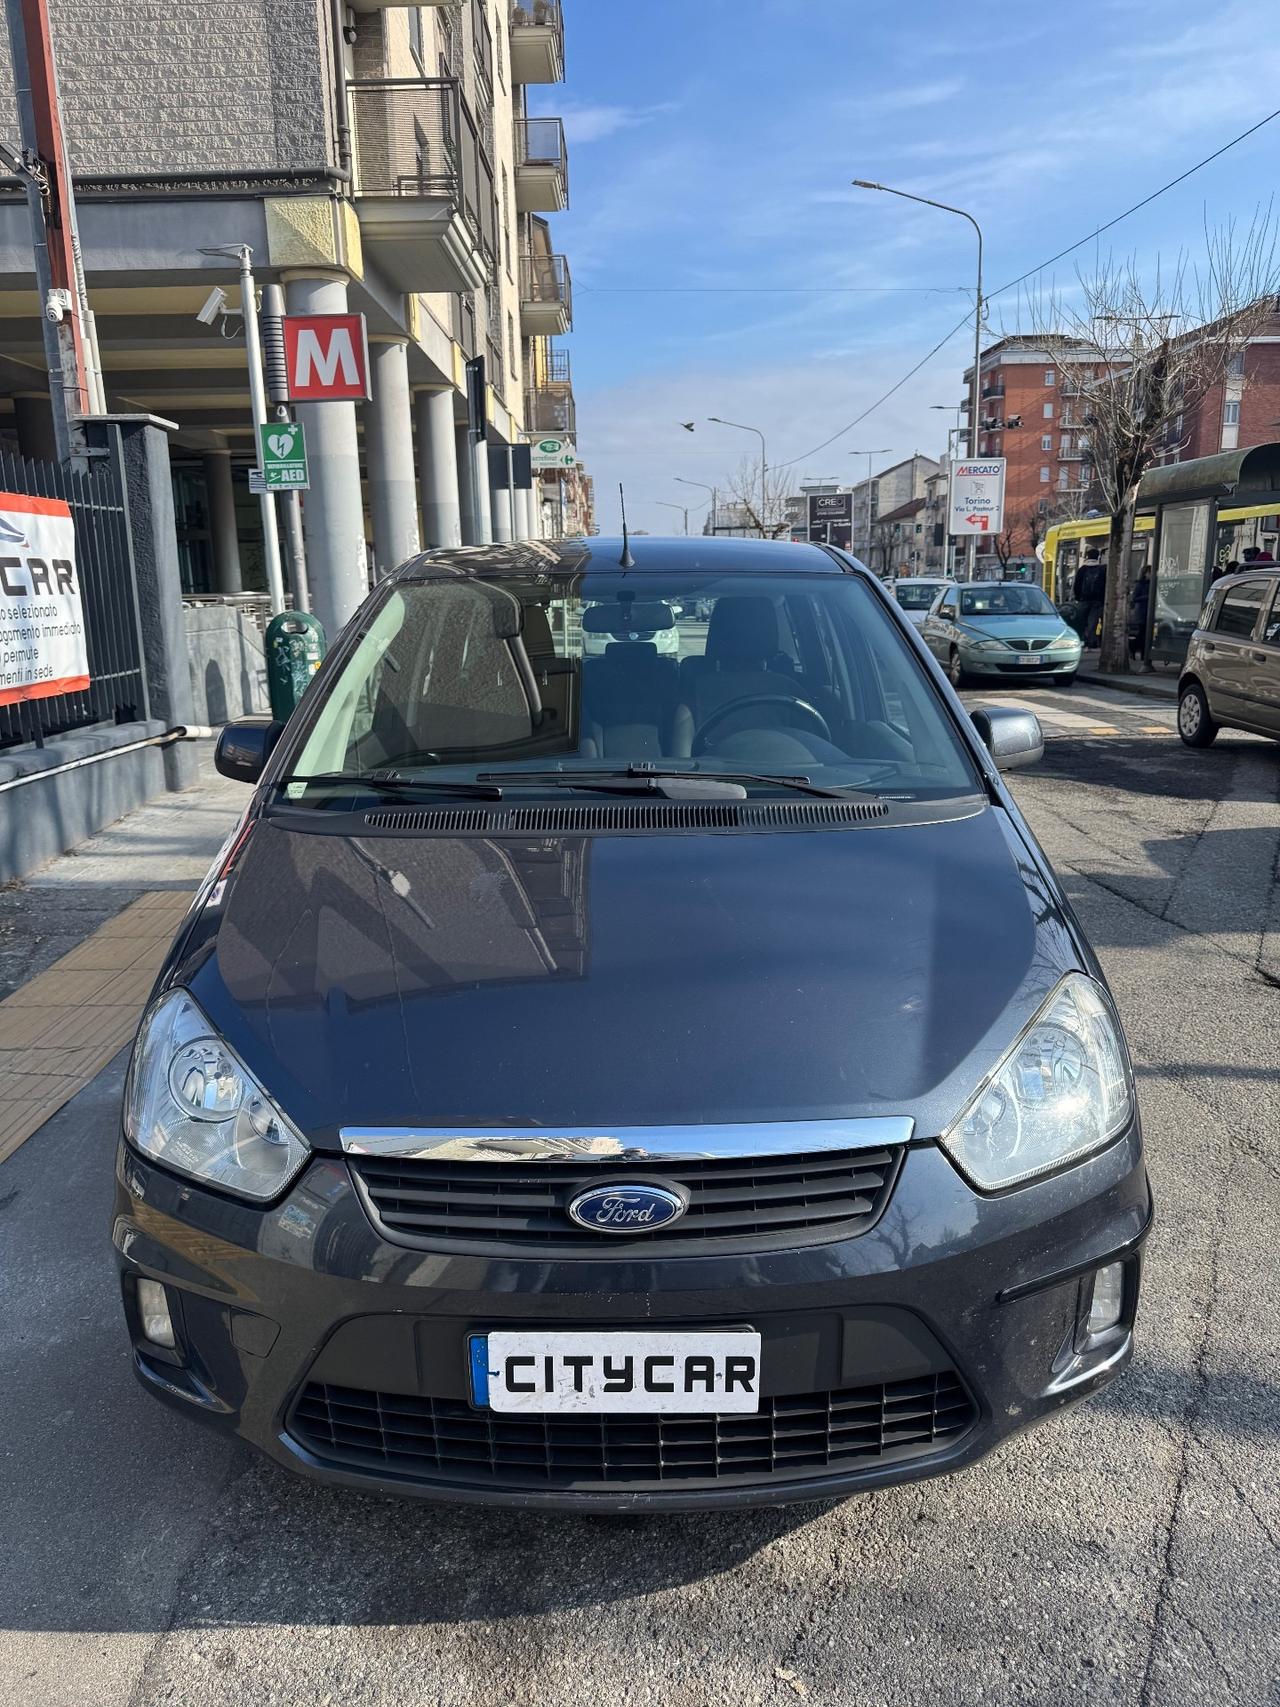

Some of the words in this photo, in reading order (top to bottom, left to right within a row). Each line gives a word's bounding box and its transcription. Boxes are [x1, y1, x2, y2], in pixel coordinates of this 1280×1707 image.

[295, 328, 360, 387] M
[281, 469, 305, 482] AED
[964, 496, 991, 505] Torino
[8, 603, 58, 620] selezionato
[42, 621, 81, 638] immediato
[4, 646, 39, 665] permute
[25, 667, 32, 682] in
[34, 663, 54, 679] sede
[595, 1197, 655, 1222] Ford
[505, 1355, 756, 1393] CITYCAR
